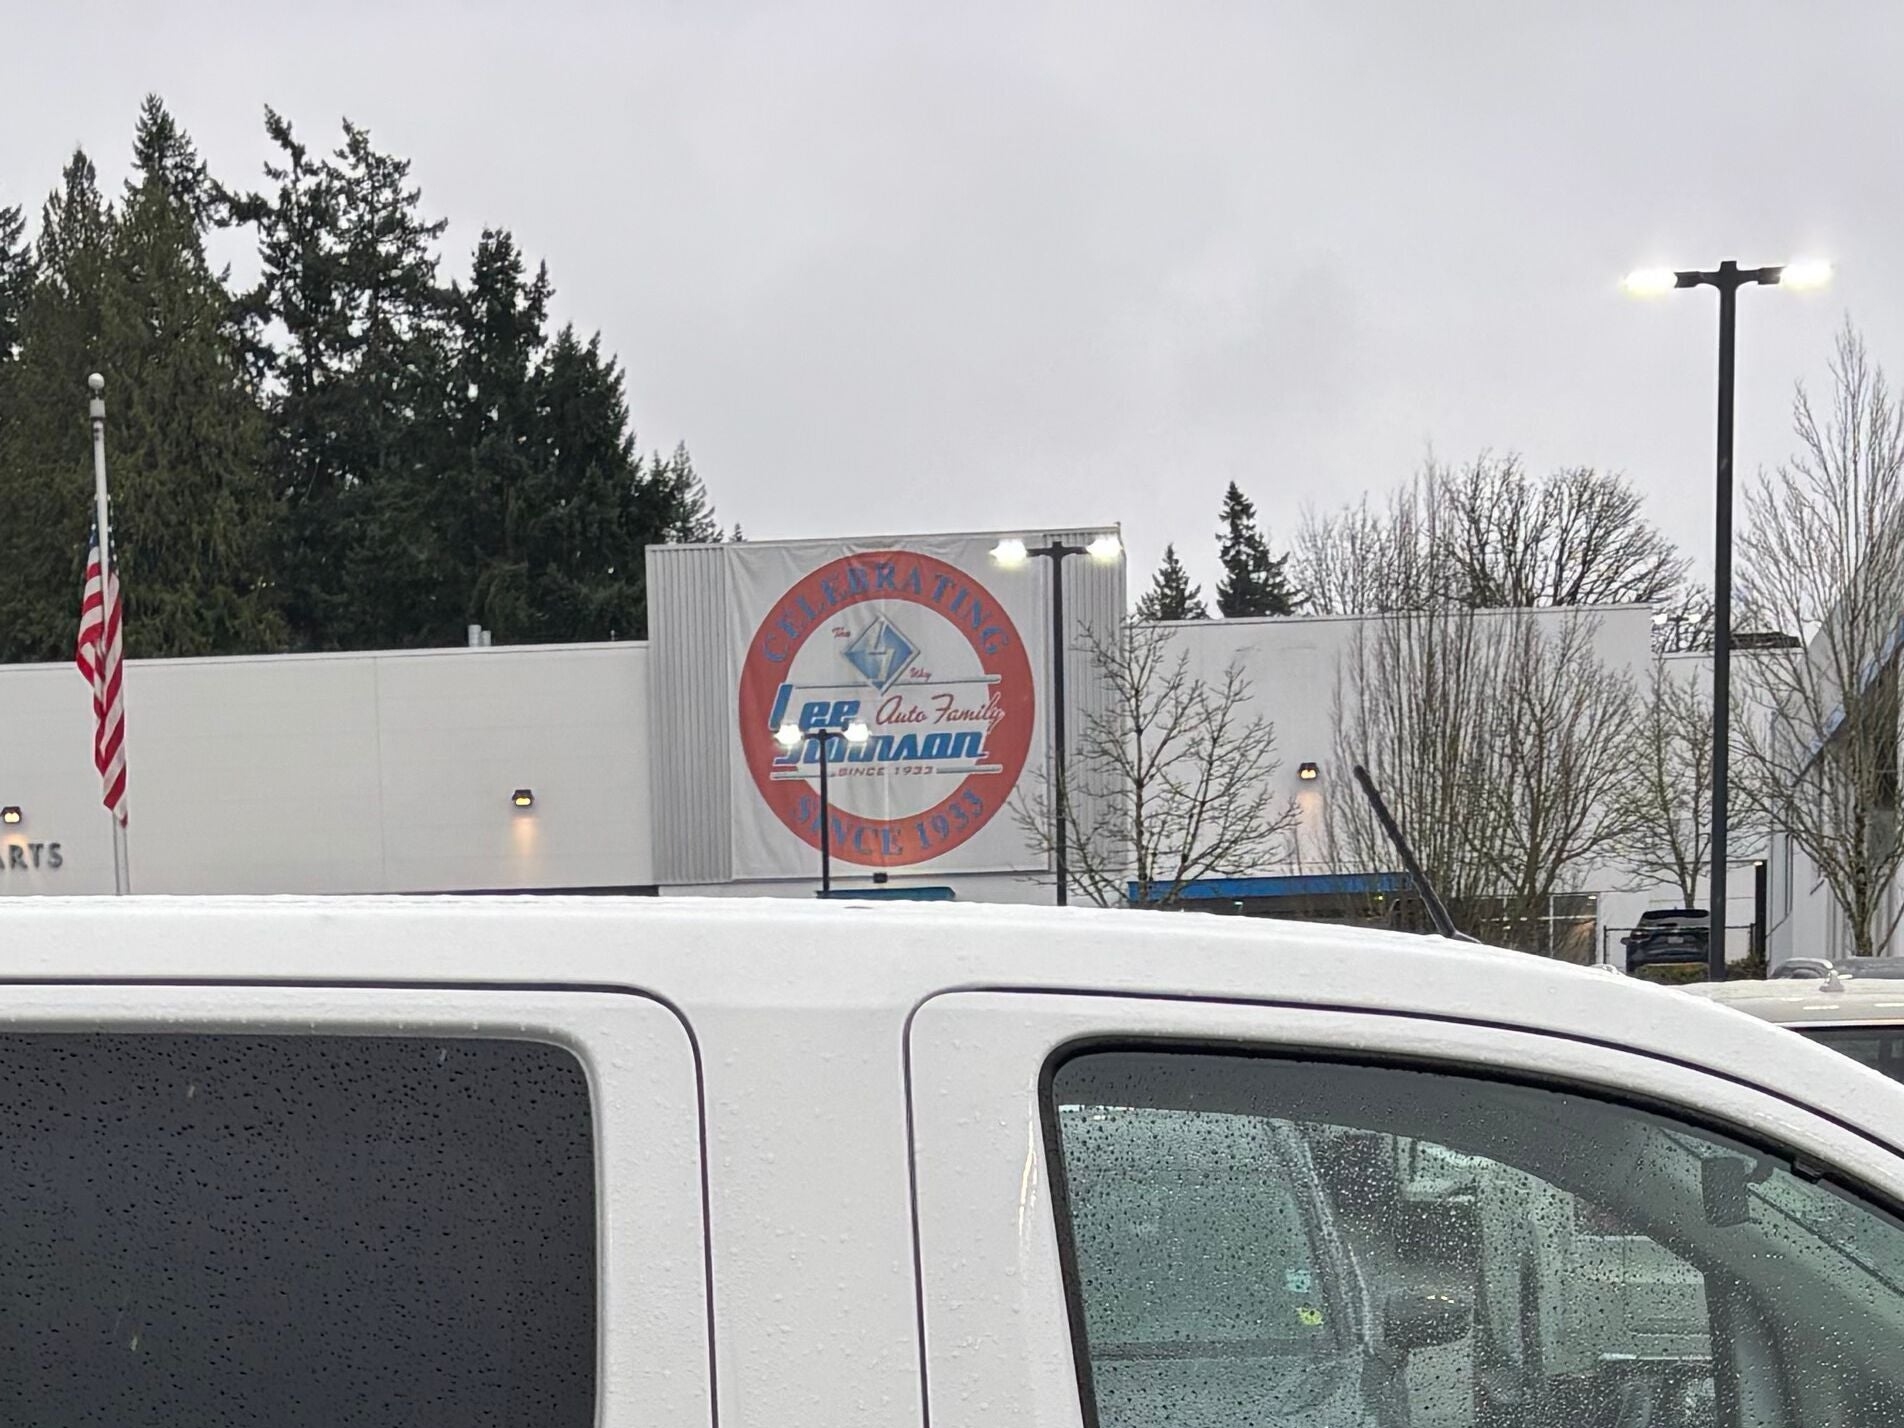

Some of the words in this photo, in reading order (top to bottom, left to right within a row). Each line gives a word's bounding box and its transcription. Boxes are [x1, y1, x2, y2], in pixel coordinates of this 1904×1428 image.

[763, 561, 1009, 662] CELEBRATING
[770, 684, 860, 732] Lee
[876, 695, 927, 725] Auto
[931, 692, 1005, 733] Family
[838, 767, 885, 777] SINCE
[895, 766, 933, 775] 1933
[915, 789, 983, 848] 1933
